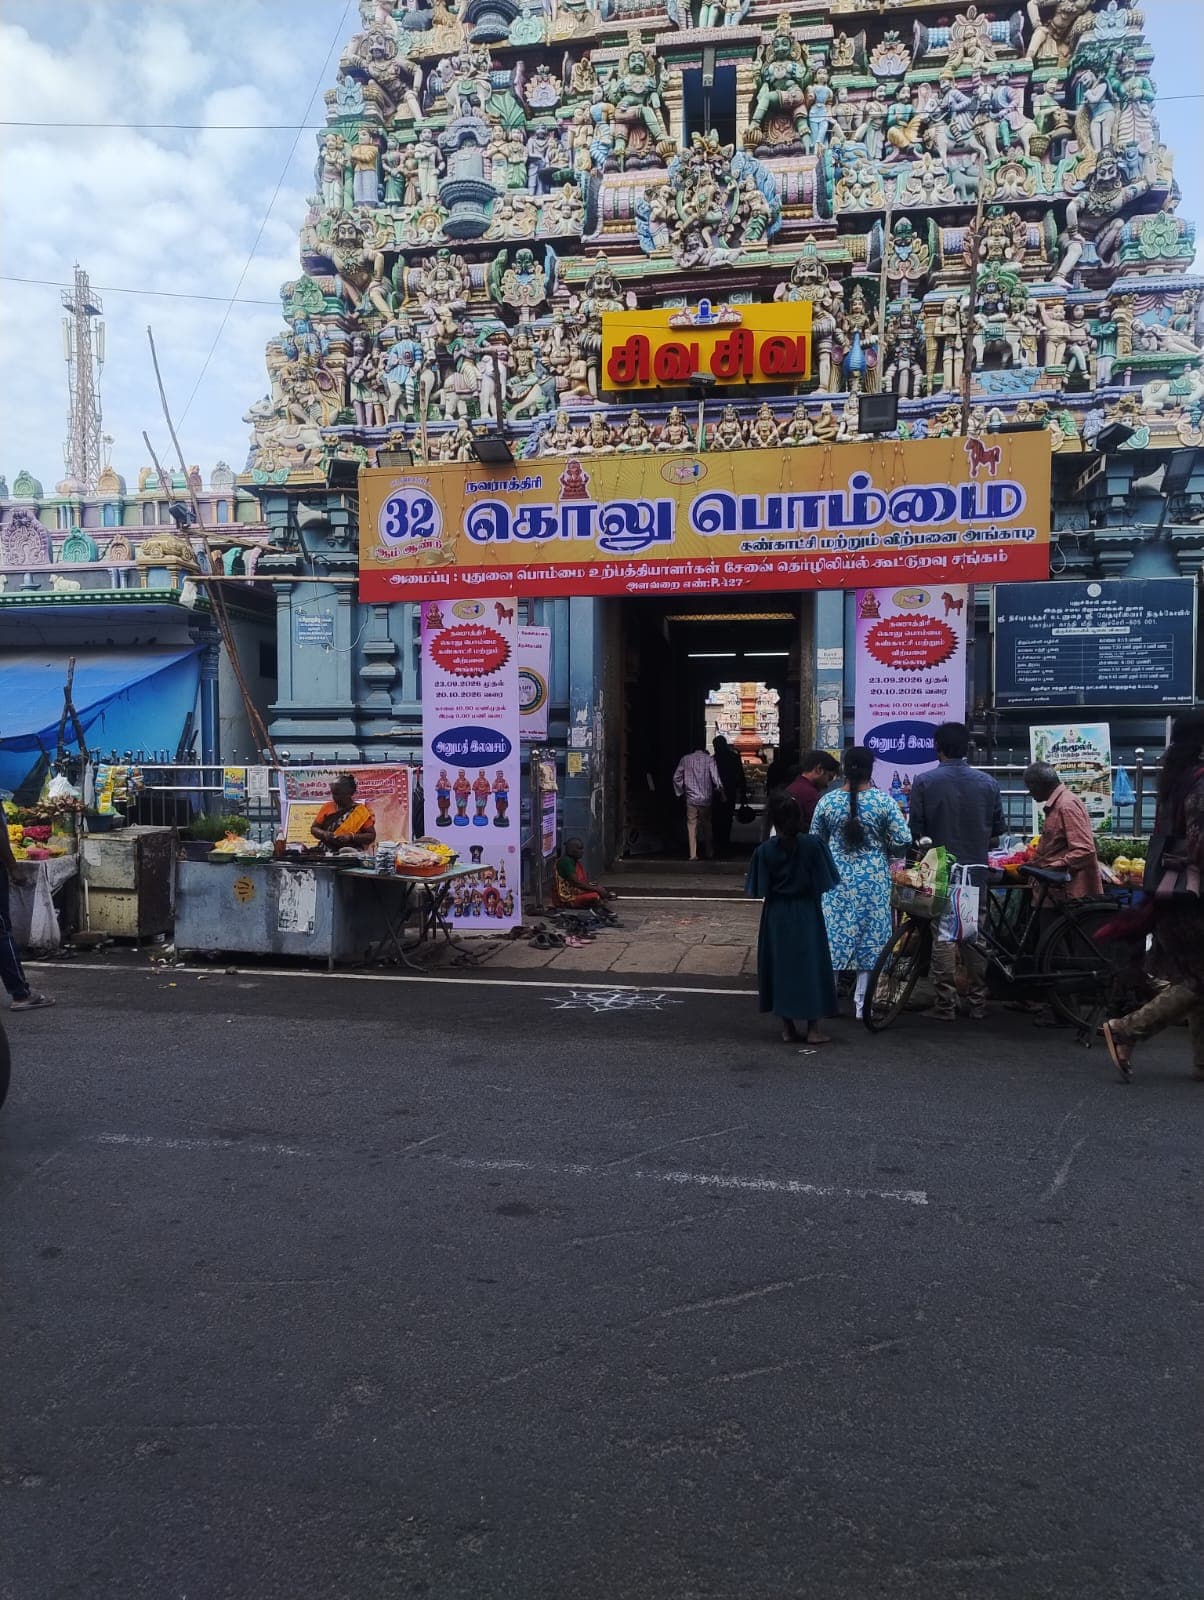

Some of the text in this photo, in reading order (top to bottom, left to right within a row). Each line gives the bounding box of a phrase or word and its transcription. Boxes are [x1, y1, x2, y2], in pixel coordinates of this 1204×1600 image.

[607, 328, 806, 384] சிவ சிவ
[465, 476, 543, 495] நவராத்திரி
[386, 498, 434, 538] 32
[466, 473, 1022, 551] கொலு பொம்மை
[376, 539, 442, 558] ஆம் ஆண்டு
[741, 527, 1036, 552] கண்காட்சி மற்றும் விற்பனை அங்காடி
[389, 571, 449, 584] அமைப்பு
[462, 571, 513, 584] புதுவை
[517, 567, 585, 580] பொம்மை
[589, 560, 720, 579] உற்பத்தியாளர்கள்
[724, 561, 774, 573] சேவை
[871, 554, 947, 568] கூட்டுறவு
[951, 549, 1008, 564] சங்கம்
[484, 679, 505, 689] முதல்
[925, 674, 950, 685] முதல்
[436, 738, 507, 757] அனுமதி இலவசம்
[868, 733, 935, 753] அனுமதி இலவ
